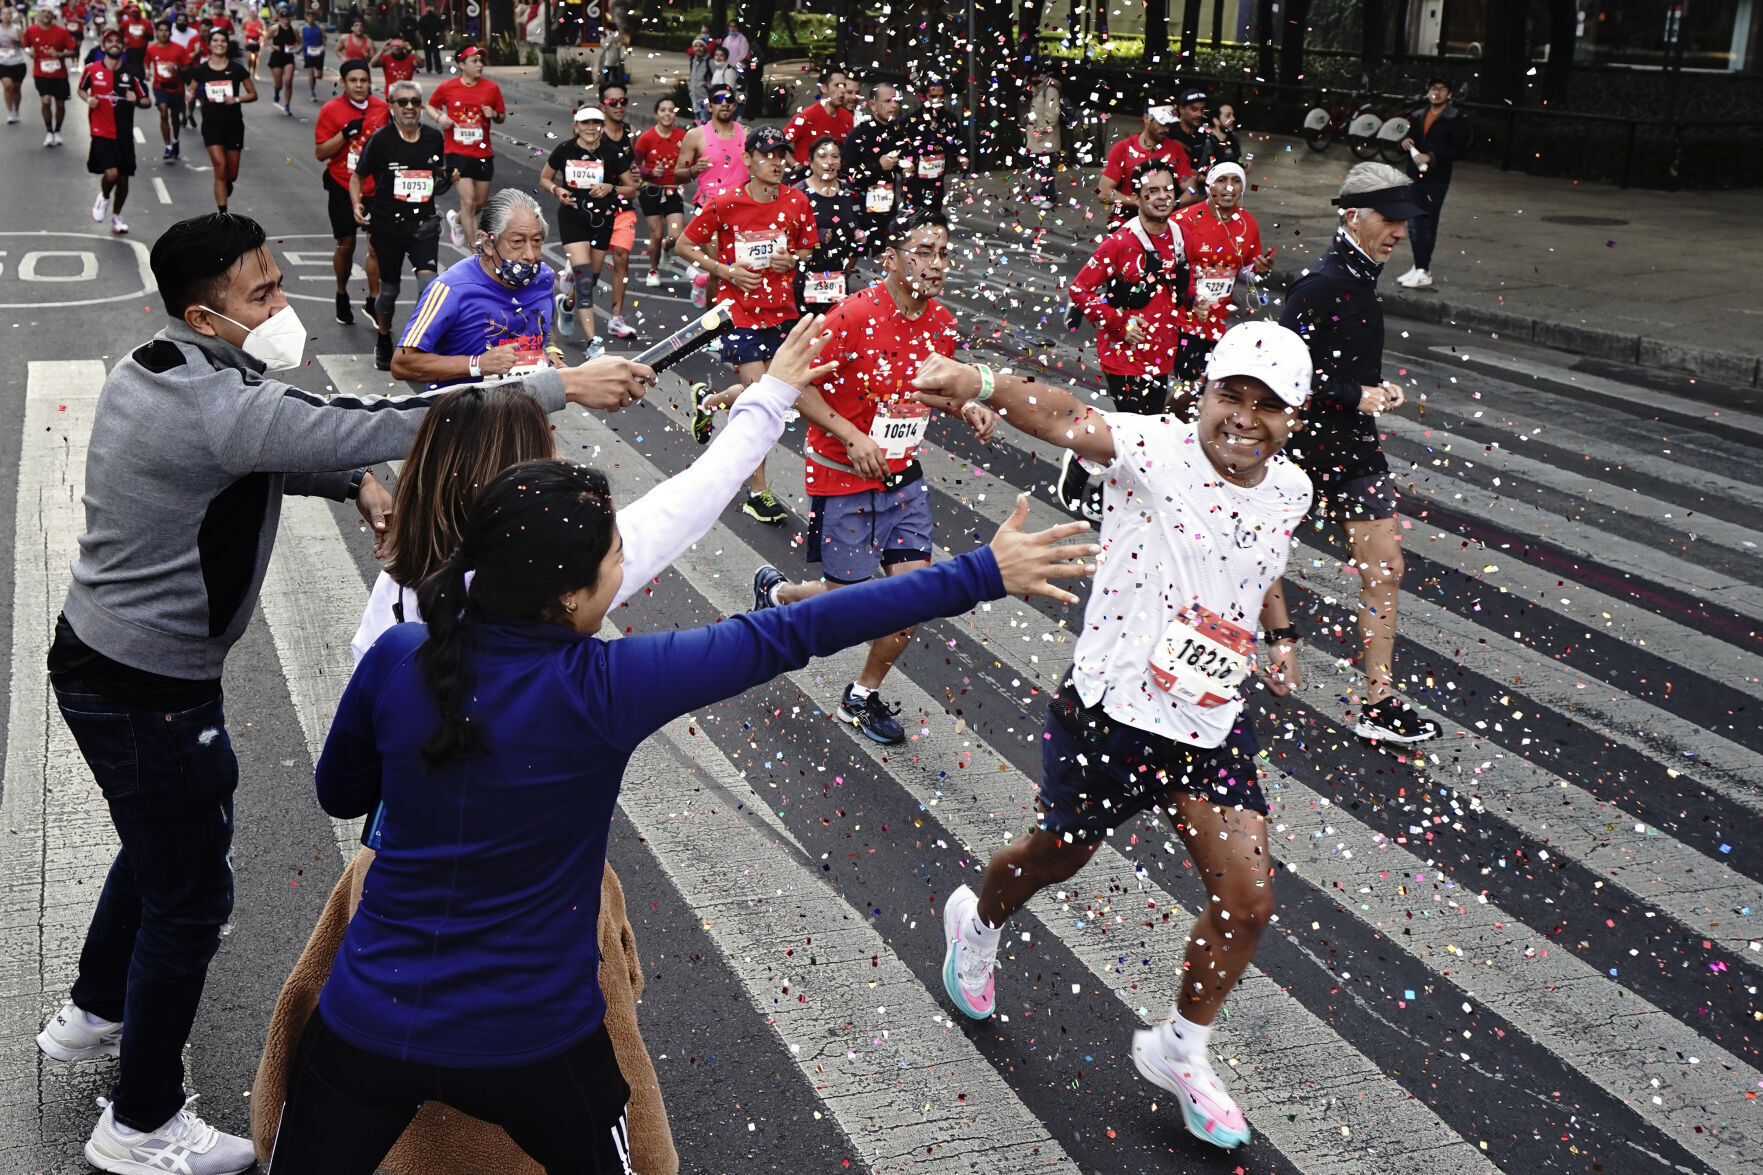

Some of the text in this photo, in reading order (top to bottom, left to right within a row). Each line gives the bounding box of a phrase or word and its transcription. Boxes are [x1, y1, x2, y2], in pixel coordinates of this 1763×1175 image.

[572, 170, 596, 179] 10744
[402, 181, 427, 191] 10753
[0, 251, 99, 282] 0
[884, 422, 918, 439] 10614
